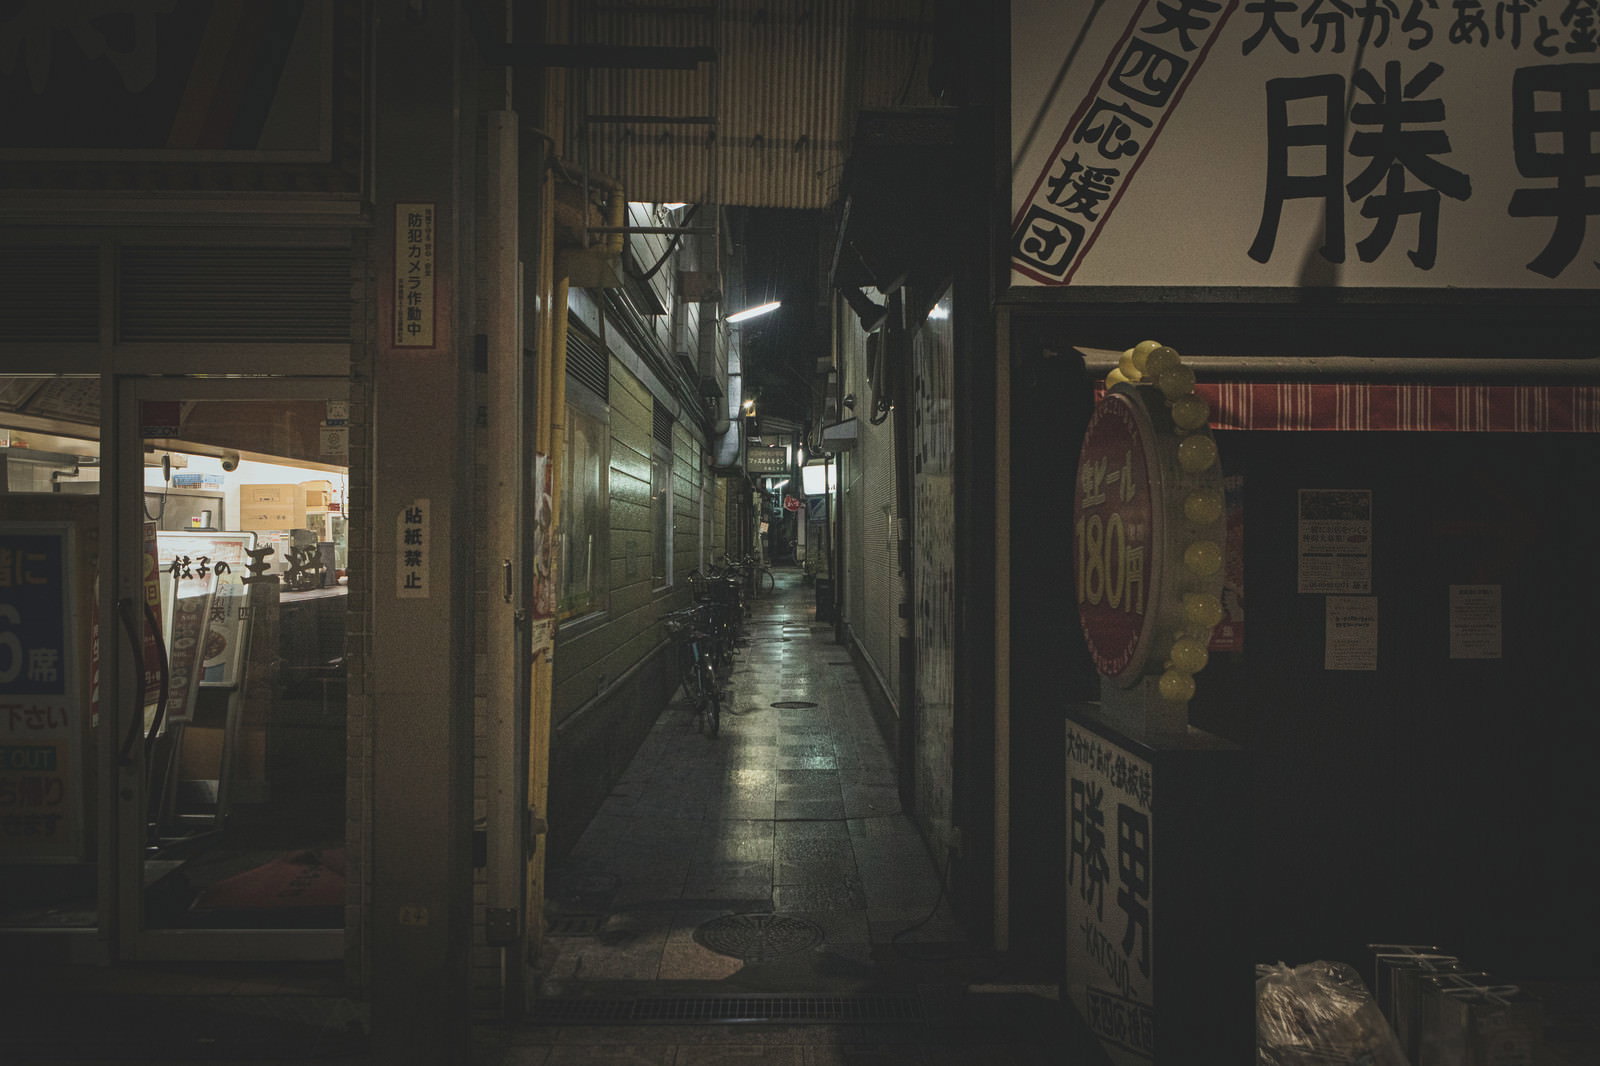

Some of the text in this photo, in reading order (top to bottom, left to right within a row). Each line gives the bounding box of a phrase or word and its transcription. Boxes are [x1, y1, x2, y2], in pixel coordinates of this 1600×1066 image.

[1014, 0, 1222, 277] 天四応援団
[407, 213, 422, 336] 防犯カメラ作動中
[169, 545, 328, 591] 餃子の王将
[403, 506, 422, 589] 貼紙禁止
[1075, 513, 1145, 615] 180円
[1068, 777, 1150, 980] 勝男
